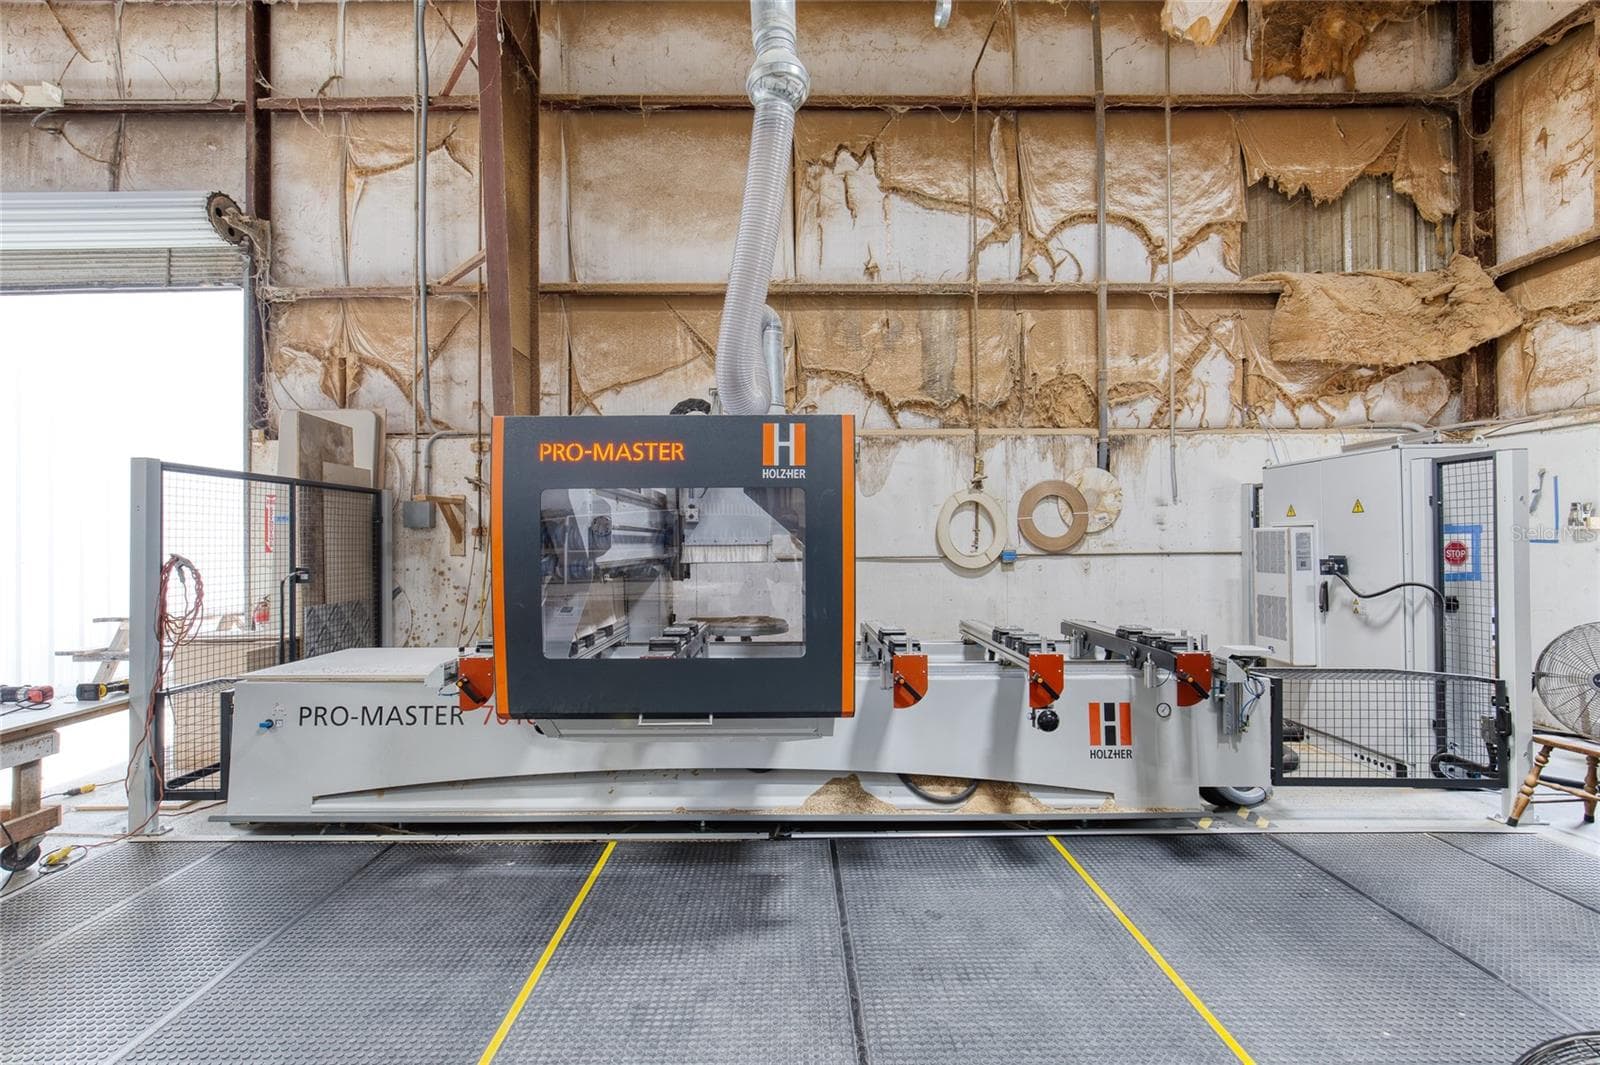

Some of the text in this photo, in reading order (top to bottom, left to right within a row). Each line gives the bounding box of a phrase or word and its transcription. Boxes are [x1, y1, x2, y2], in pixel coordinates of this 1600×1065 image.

[538, 442, 684, 461] PRO-MASTER
[1446, 549, 1466, 559] STOP
[299, 706, 464, 726] PRO-MASTER
